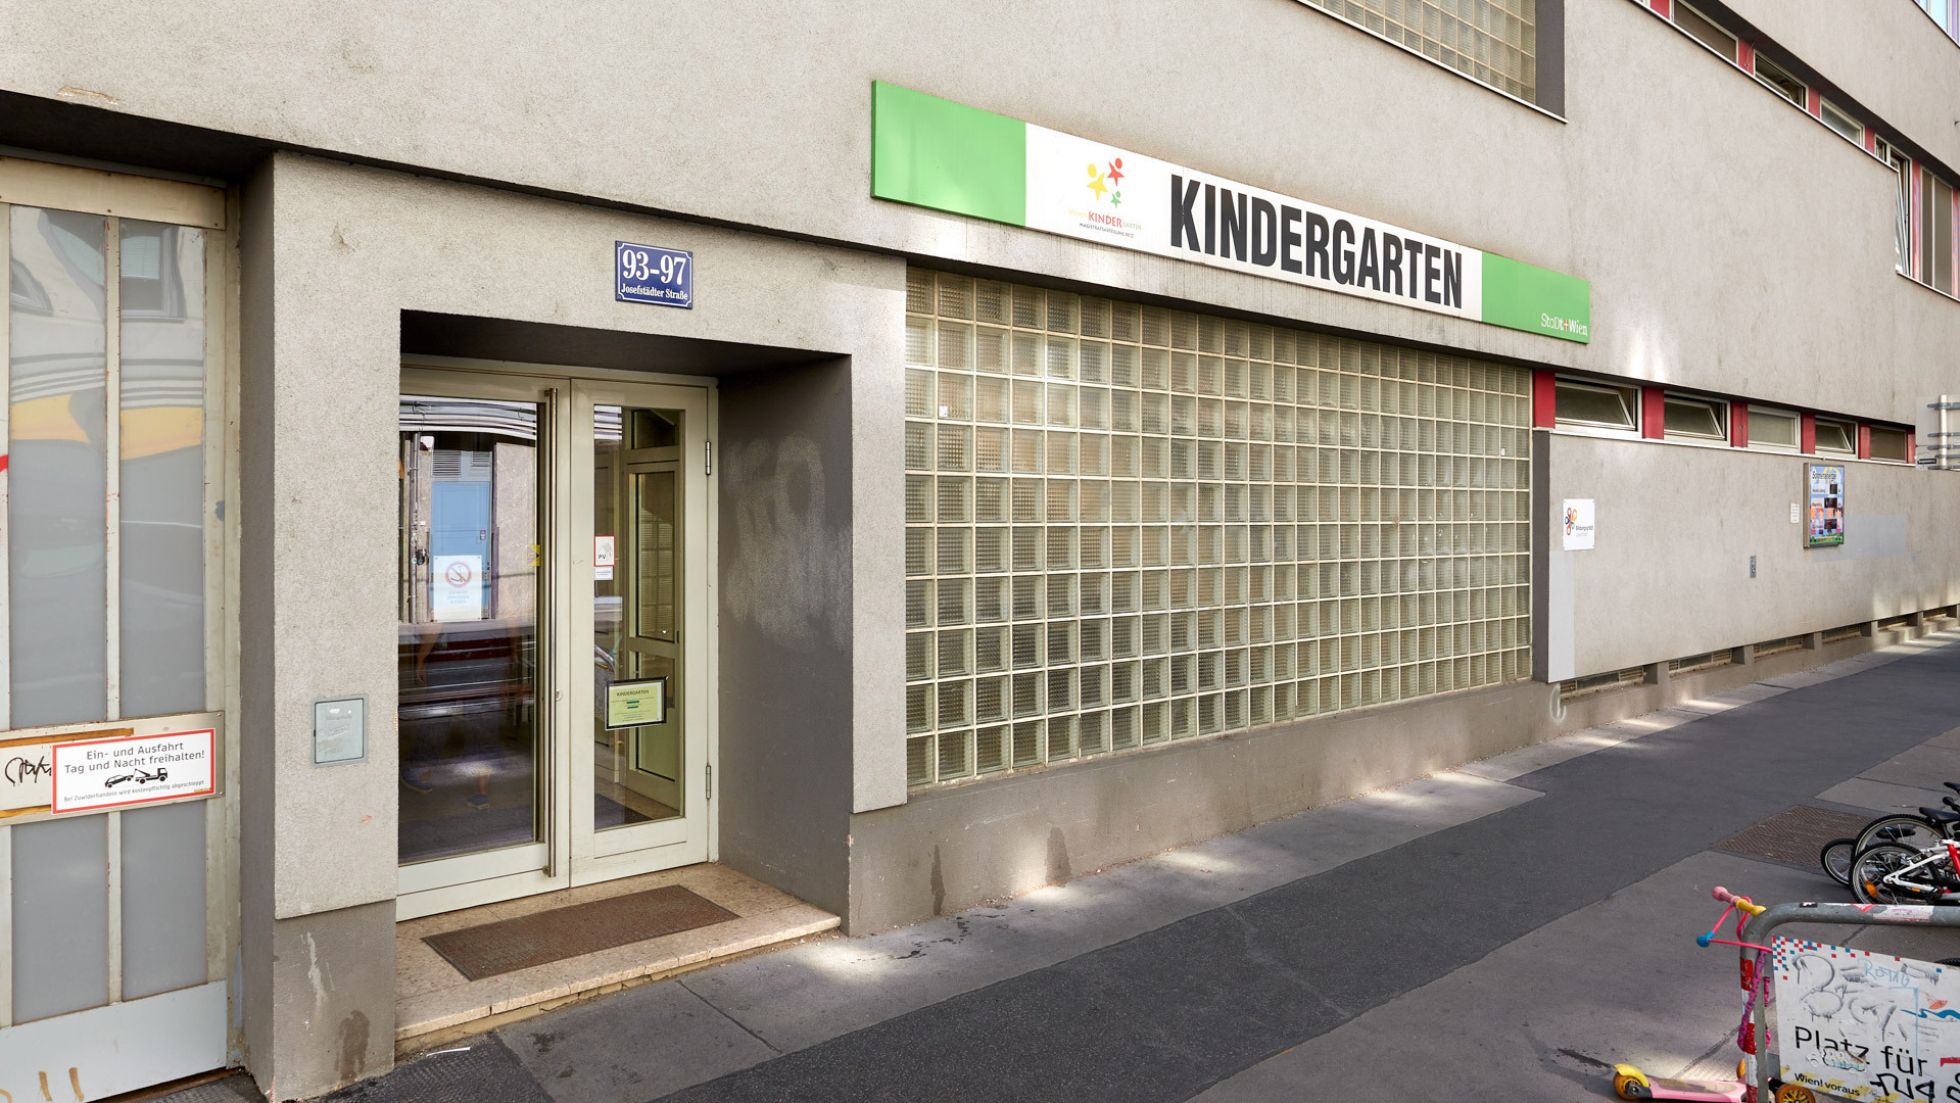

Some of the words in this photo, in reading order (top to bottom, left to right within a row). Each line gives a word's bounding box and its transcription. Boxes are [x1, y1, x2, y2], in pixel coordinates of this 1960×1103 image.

[1088, 211, 1122, 228] KINDER
[1171, 174, 1462, 309] KINDERGARTEN
[622, 249, 686, 285] 93-97
[621, 283, 664, 297] Josefstädter
[665, 288, 688, 300] Straße
[87, 750, 109, 760] Ein-
[113, 747, 134, 757] und
[137, 742, 184, 755] Ausfahrt
[64, 764, 85, 774] Tag
[89, 761, 109, 771] und
[114, 757, 146, 768] Nacht
[149, 750, 204, 764] freihalten!
[1795, 1026, 1870, 1064] Platz
[1880, 1045, 1928, 1077] für
[1825, 1081, 1861, 1098] voraus
